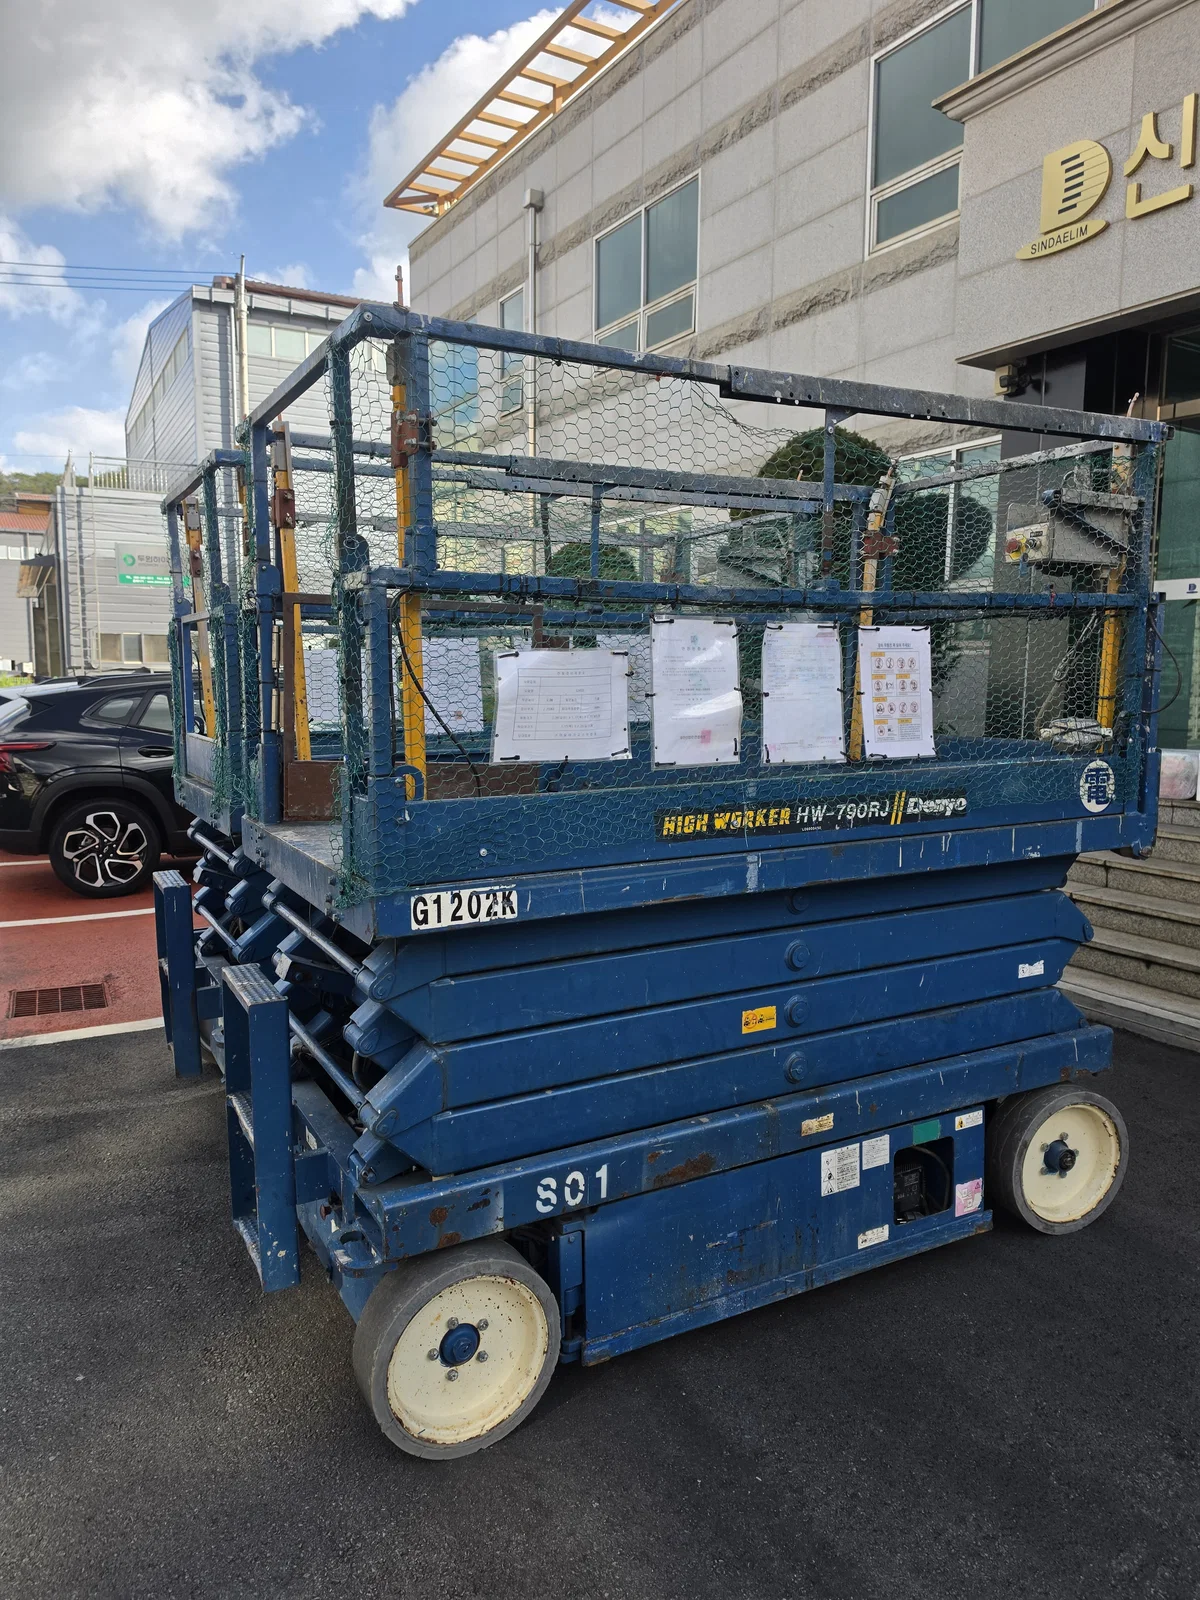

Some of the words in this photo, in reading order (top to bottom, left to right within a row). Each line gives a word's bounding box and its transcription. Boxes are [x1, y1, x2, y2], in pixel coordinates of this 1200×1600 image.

[1124, 93, 1199, 220] 신
[1030, 224, 1089, 255] SINDAELIM
[662, 813, 709, 836] HIGH
[713, 807, 791, 831] WORKER
[796, 800, 890, 824] HW-790RJ
[906, 797, 968, 816] Denyo
[412, 890, 516, 927] G1202K
